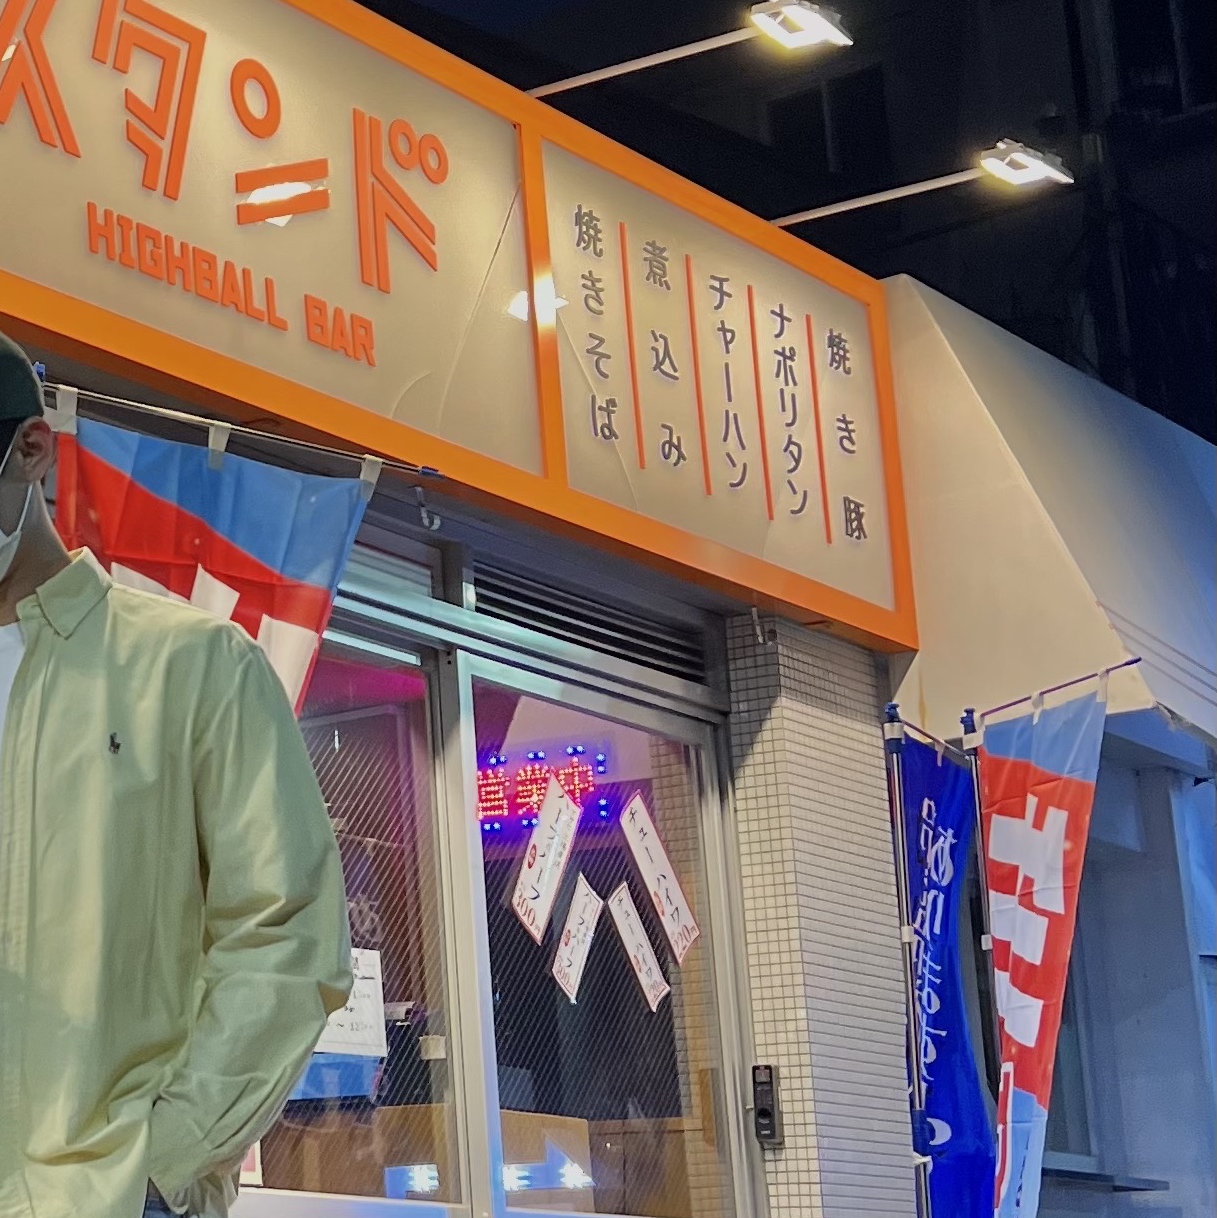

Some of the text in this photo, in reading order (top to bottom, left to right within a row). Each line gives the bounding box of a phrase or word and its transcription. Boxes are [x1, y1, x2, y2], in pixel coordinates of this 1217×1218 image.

[86, 200, 378, 368] HIGHBALL BAR
[573, 204, 620, 442] 焼きそば
[642, 239, 687, 467] 煮込み
[707, 273, 749, 490] チャーハン
[769, 302, 809, 517] ナポリタン
[826, 328, 868, 542] 焼き豚
